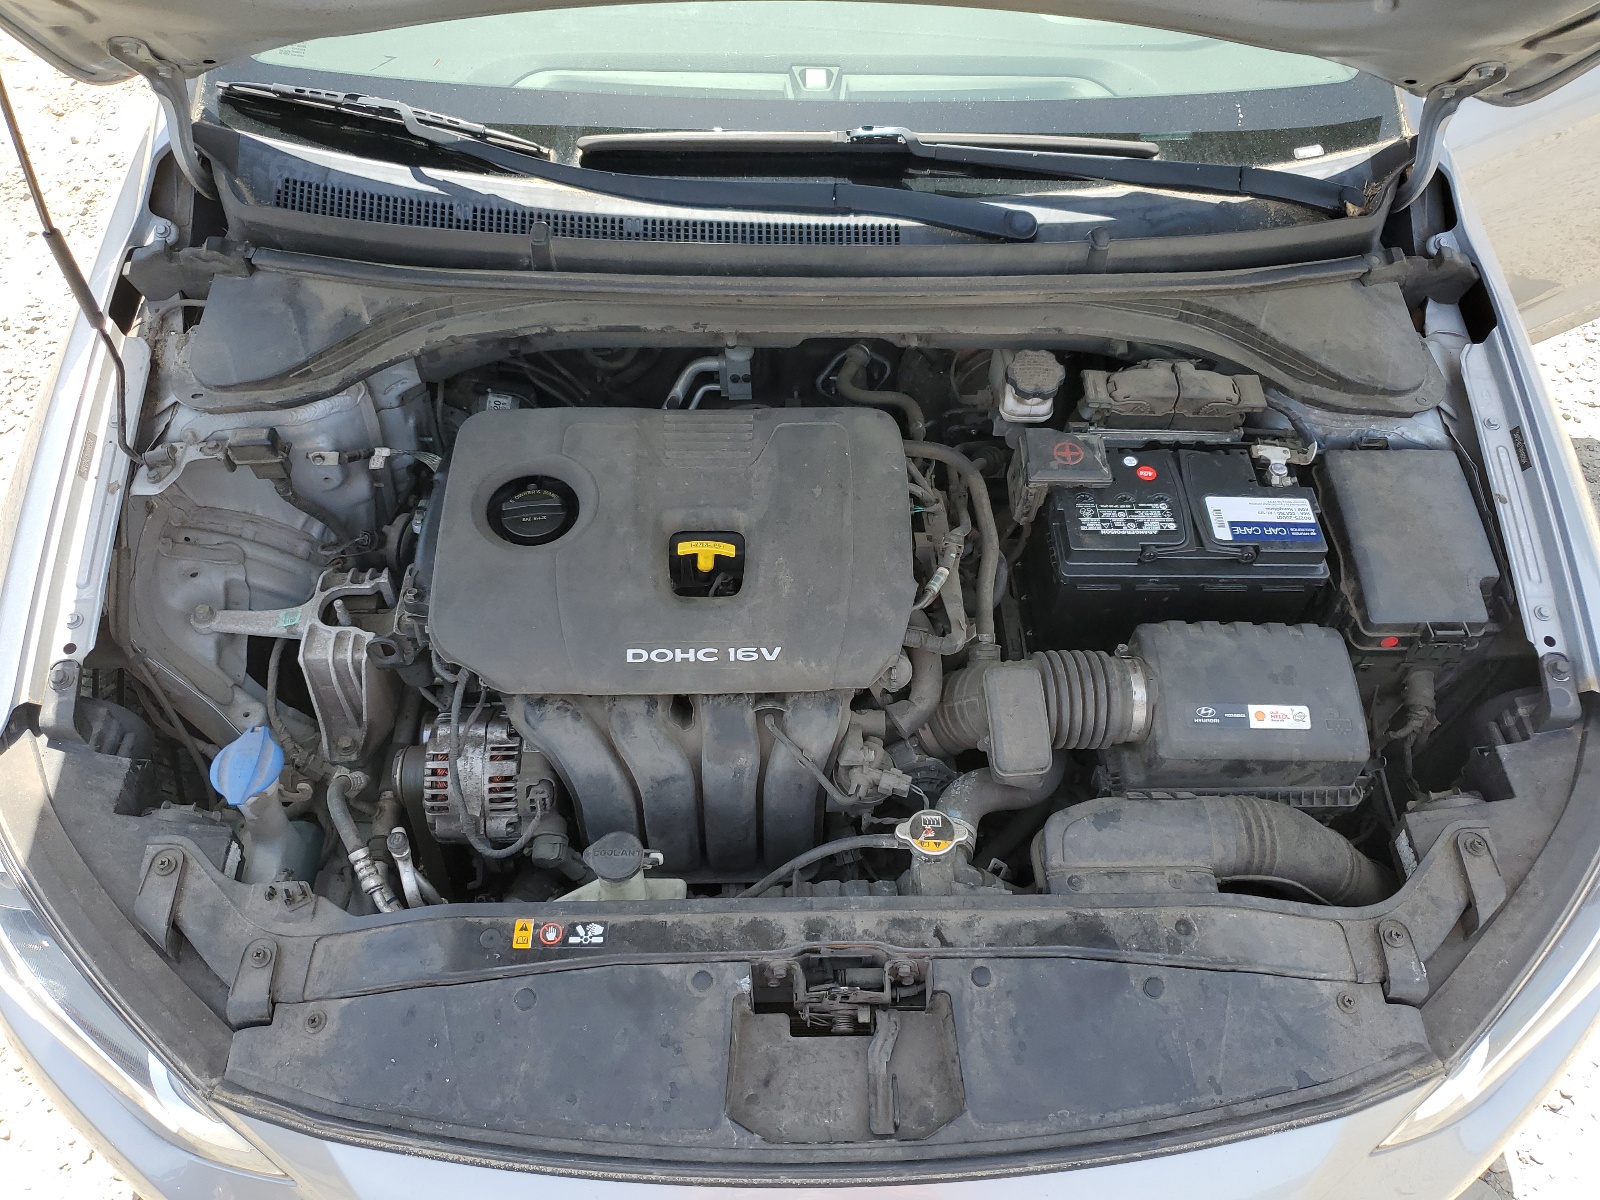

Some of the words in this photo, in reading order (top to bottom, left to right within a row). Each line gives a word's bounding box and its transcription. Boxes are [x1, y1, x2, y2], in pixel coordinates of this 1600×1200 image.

[1231, 526, 1261, 535] CARE
[1263, 526, 1287, 536] CAR
[626, 647, 719, 663] DOHC
[728, 646, 782, 662] 16V
[593, 848, 642, 858] COOLANT
